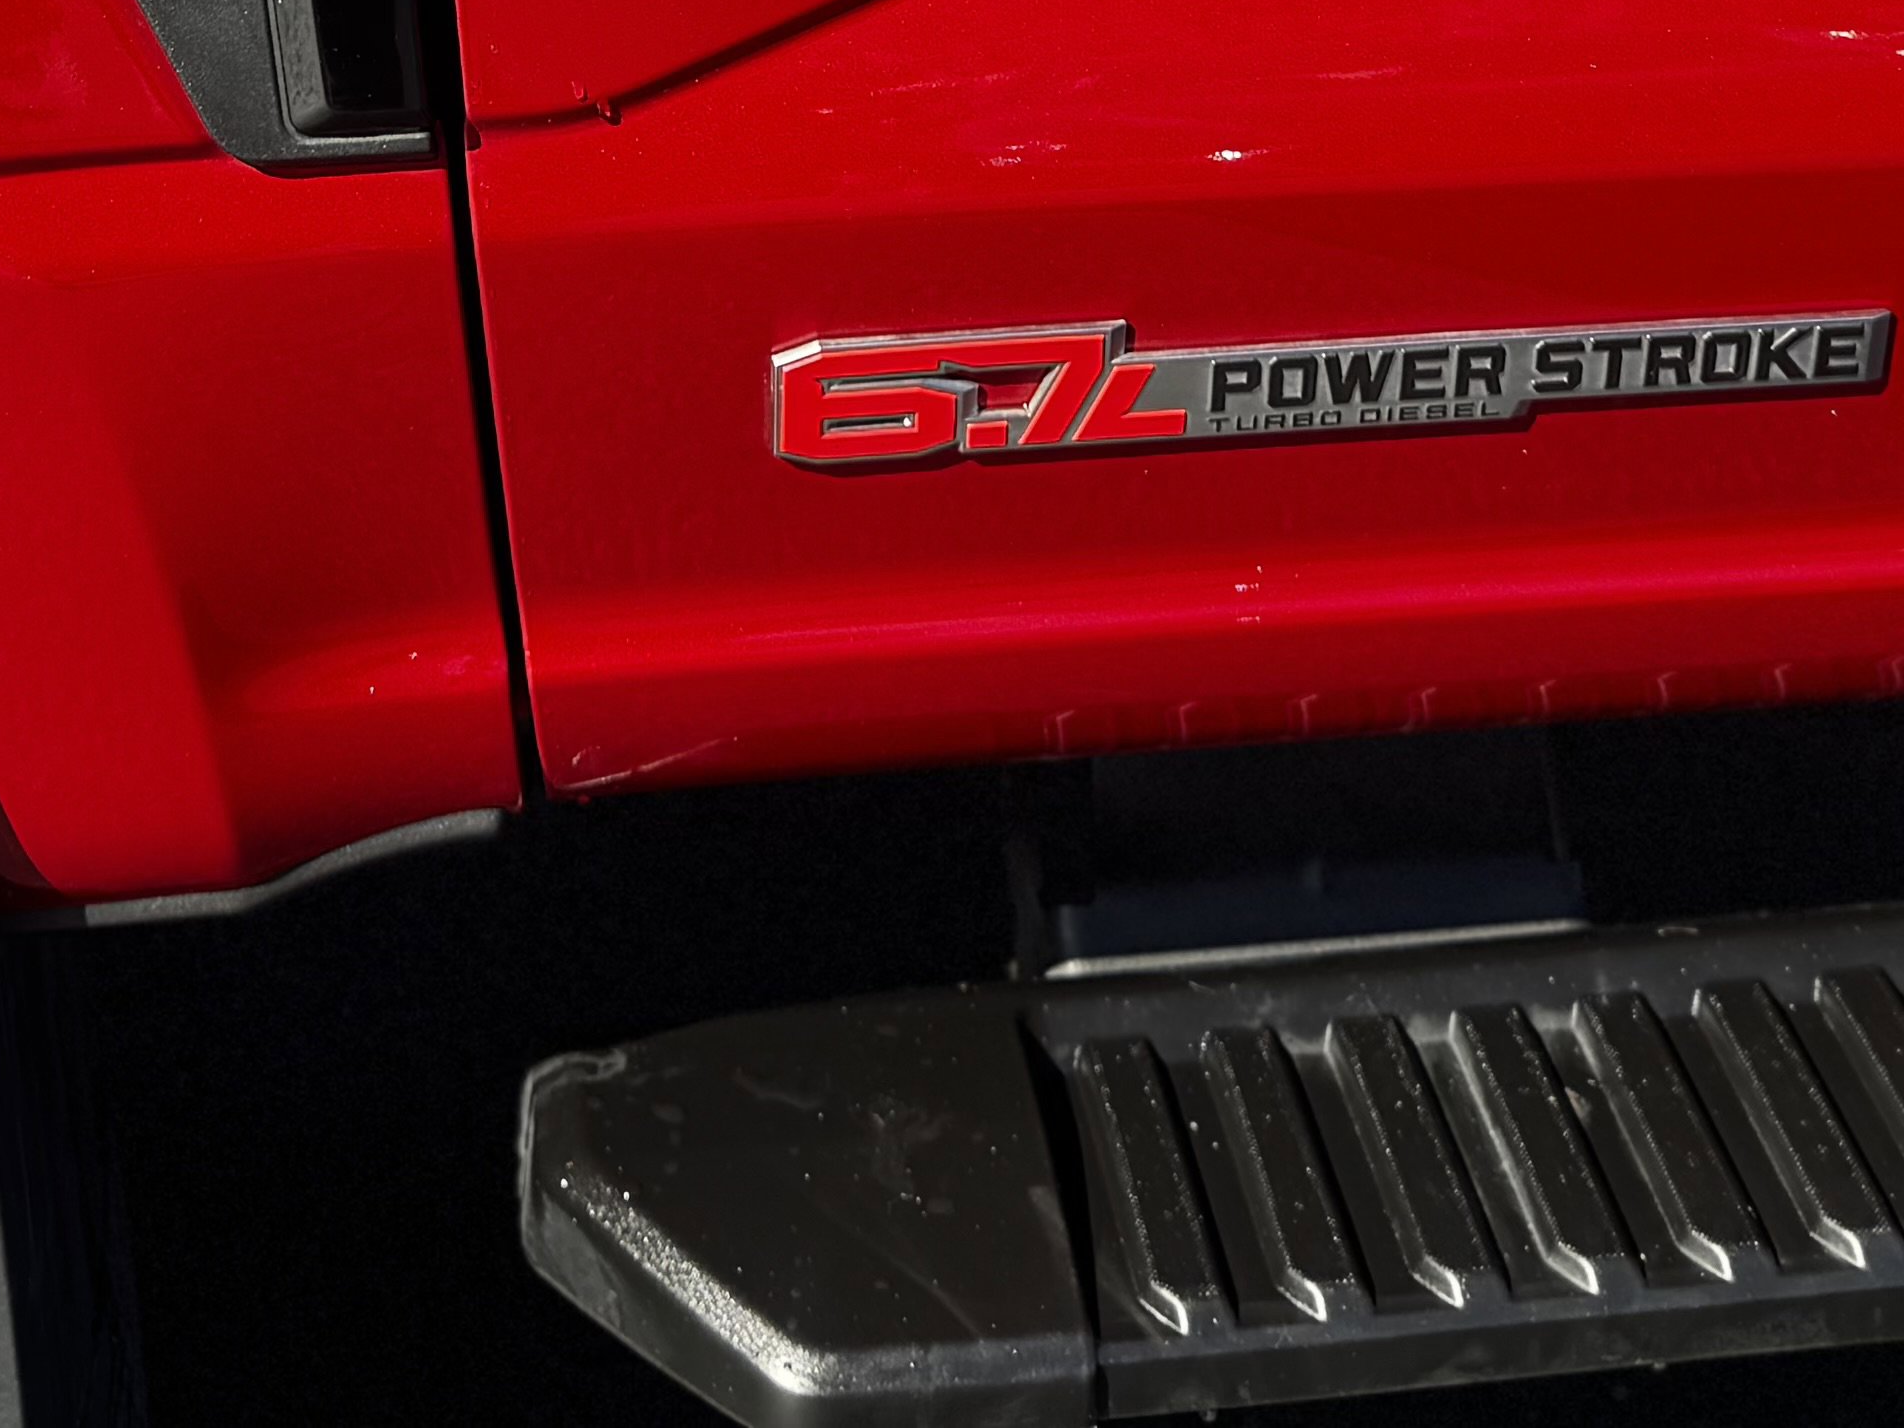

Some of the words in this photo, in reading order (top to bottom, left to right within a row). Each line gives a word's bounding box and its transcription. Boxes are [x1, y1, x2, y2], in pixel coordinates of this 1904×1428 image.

[778, 333, 1187, 459] 6.7L
[1209, 343, 1505, 413] POWER
[1530, 322, 1866, 393] STROKE
[1207, 410, 1342, 433] TURBO
[1359, 400, 1501, 425] DIESEL
